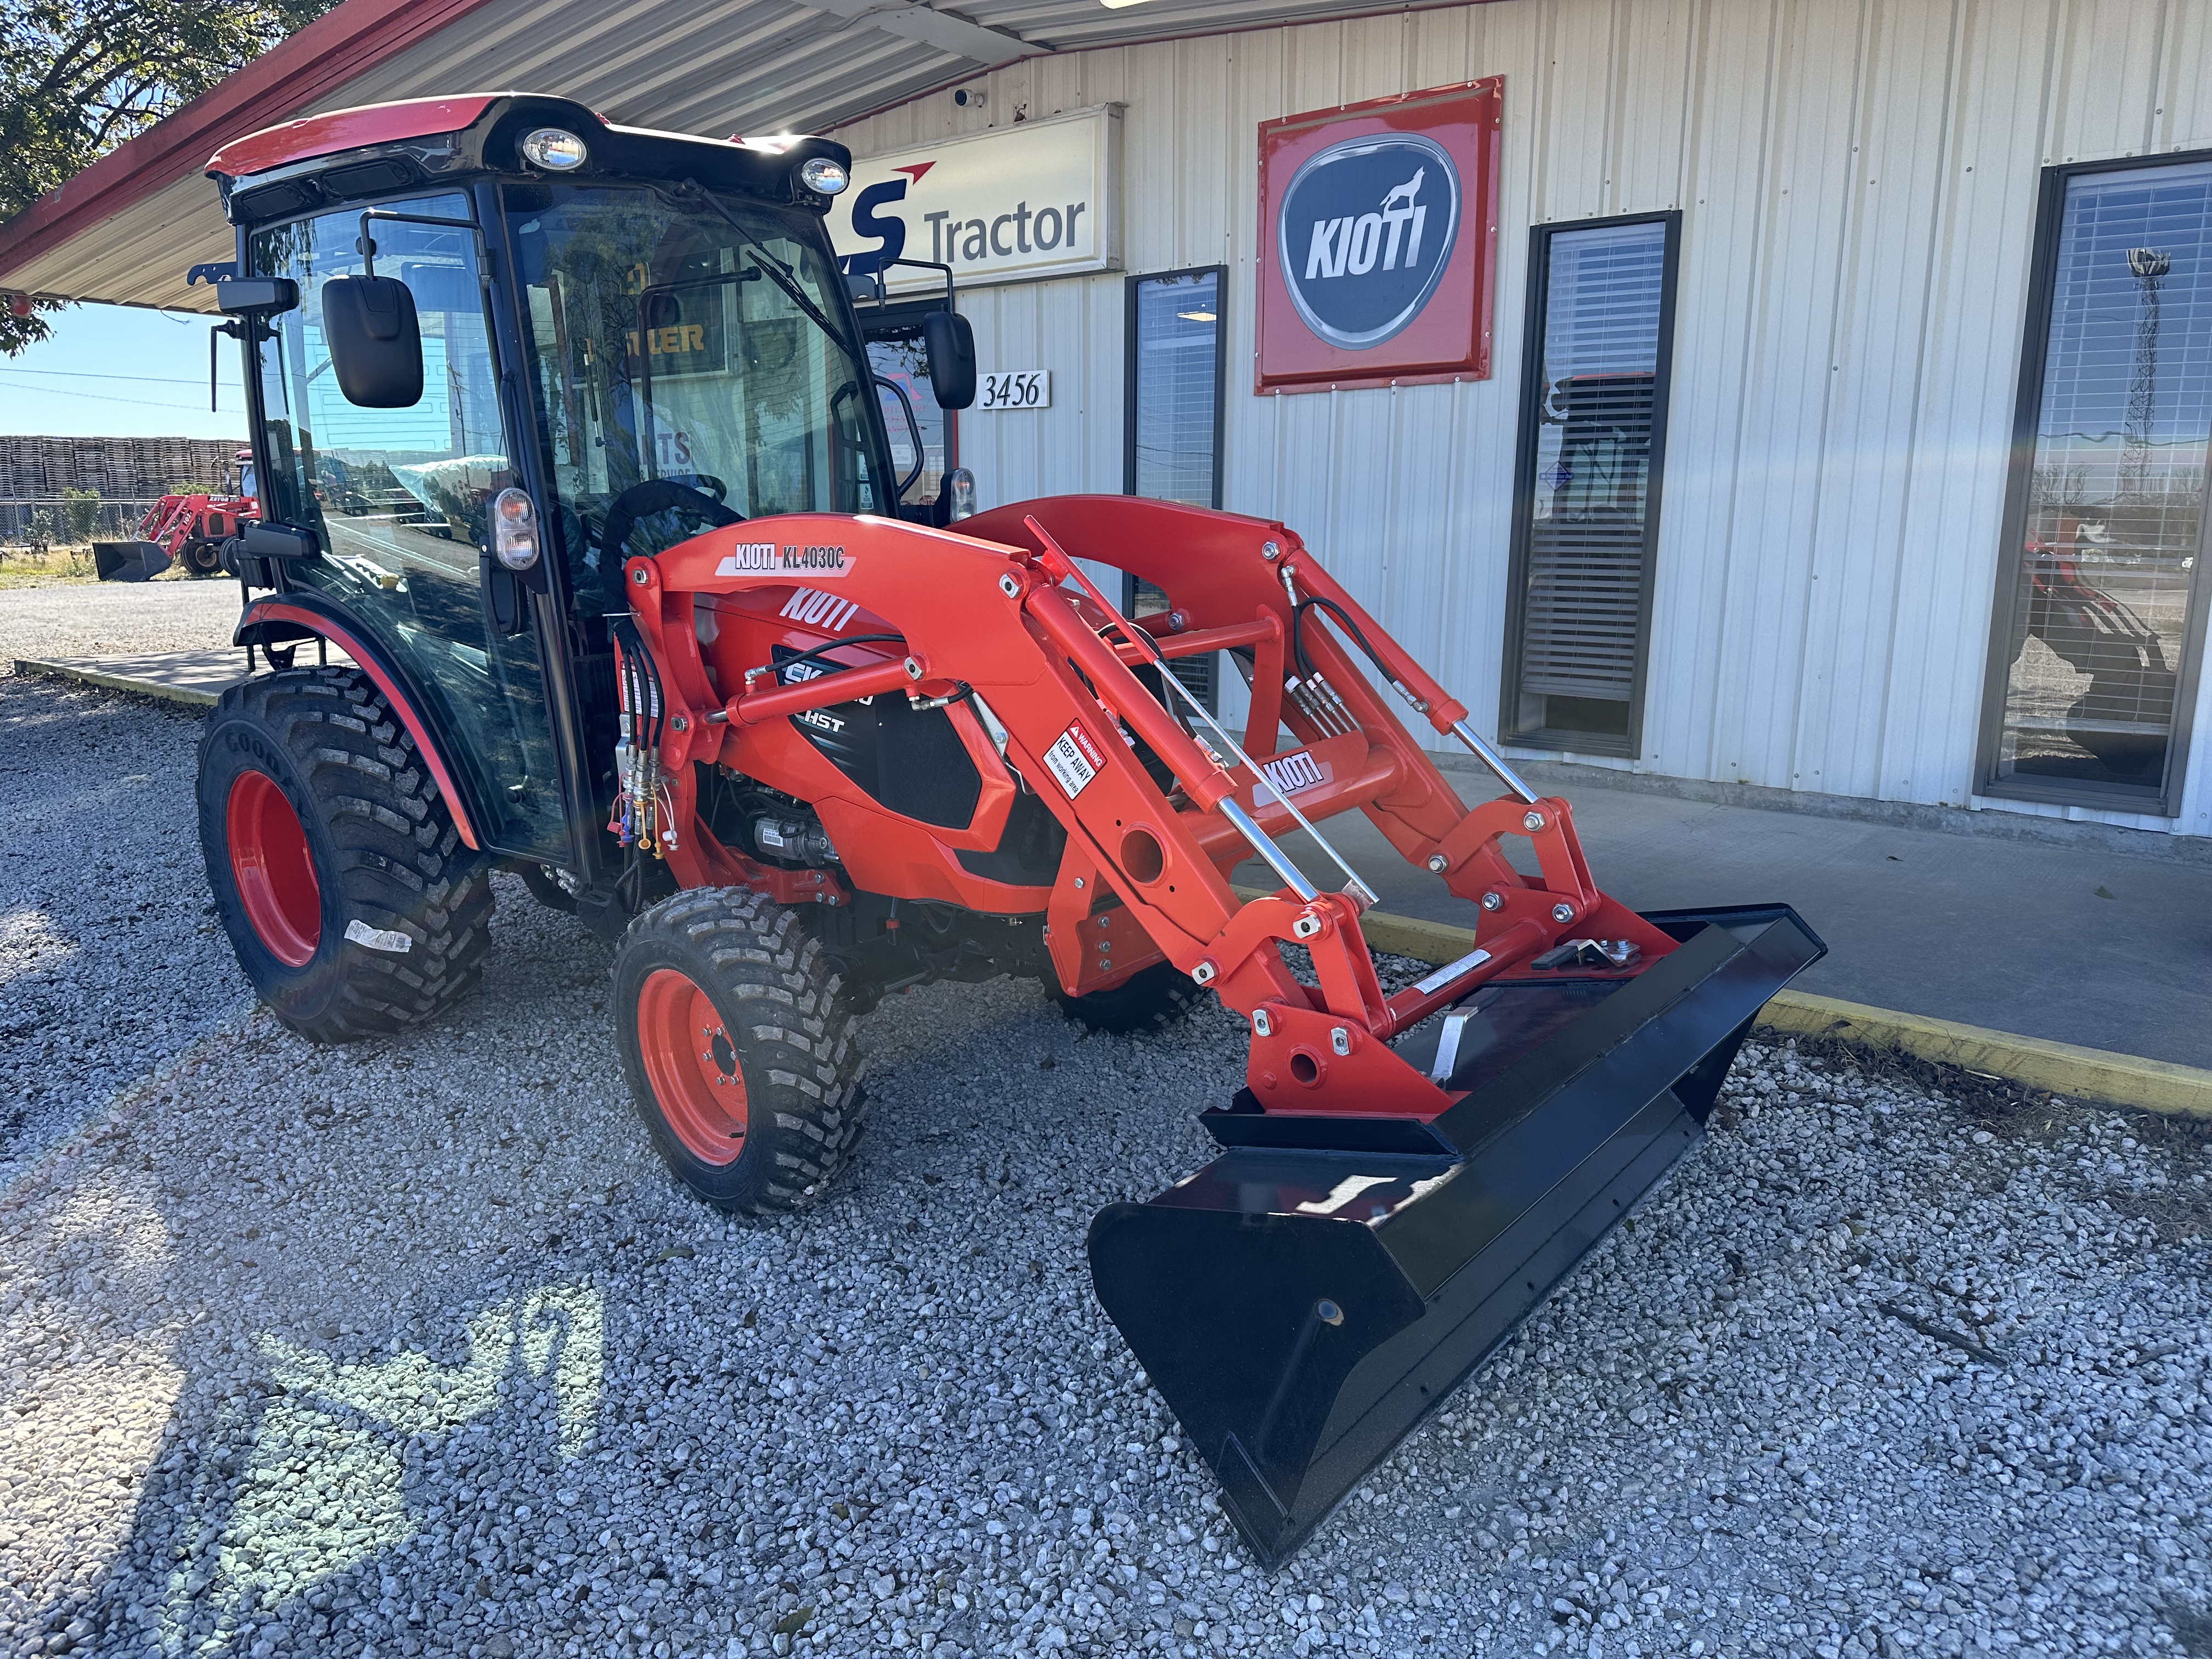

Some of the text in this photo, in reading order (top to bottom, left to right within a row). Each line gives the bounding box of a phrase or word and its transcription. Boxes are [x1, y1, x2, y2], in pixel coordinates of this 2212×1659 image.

[924, 201, 1085, 263] Tractor
[1305, 205, 1427, 280] KIOTI
[983, 373, 1041, 407] 3456
[735, 543, 845, 569] KIOTI KL4030C
[804, 710, 845, 732] HST
[1048, 750, 1079, 793] from working area
[1057, 737, 1091, 782] KEEP AWAY
[1078, 733, 1103, 768] WARNING
[1261, 751, 1324, 793] KIOTI
